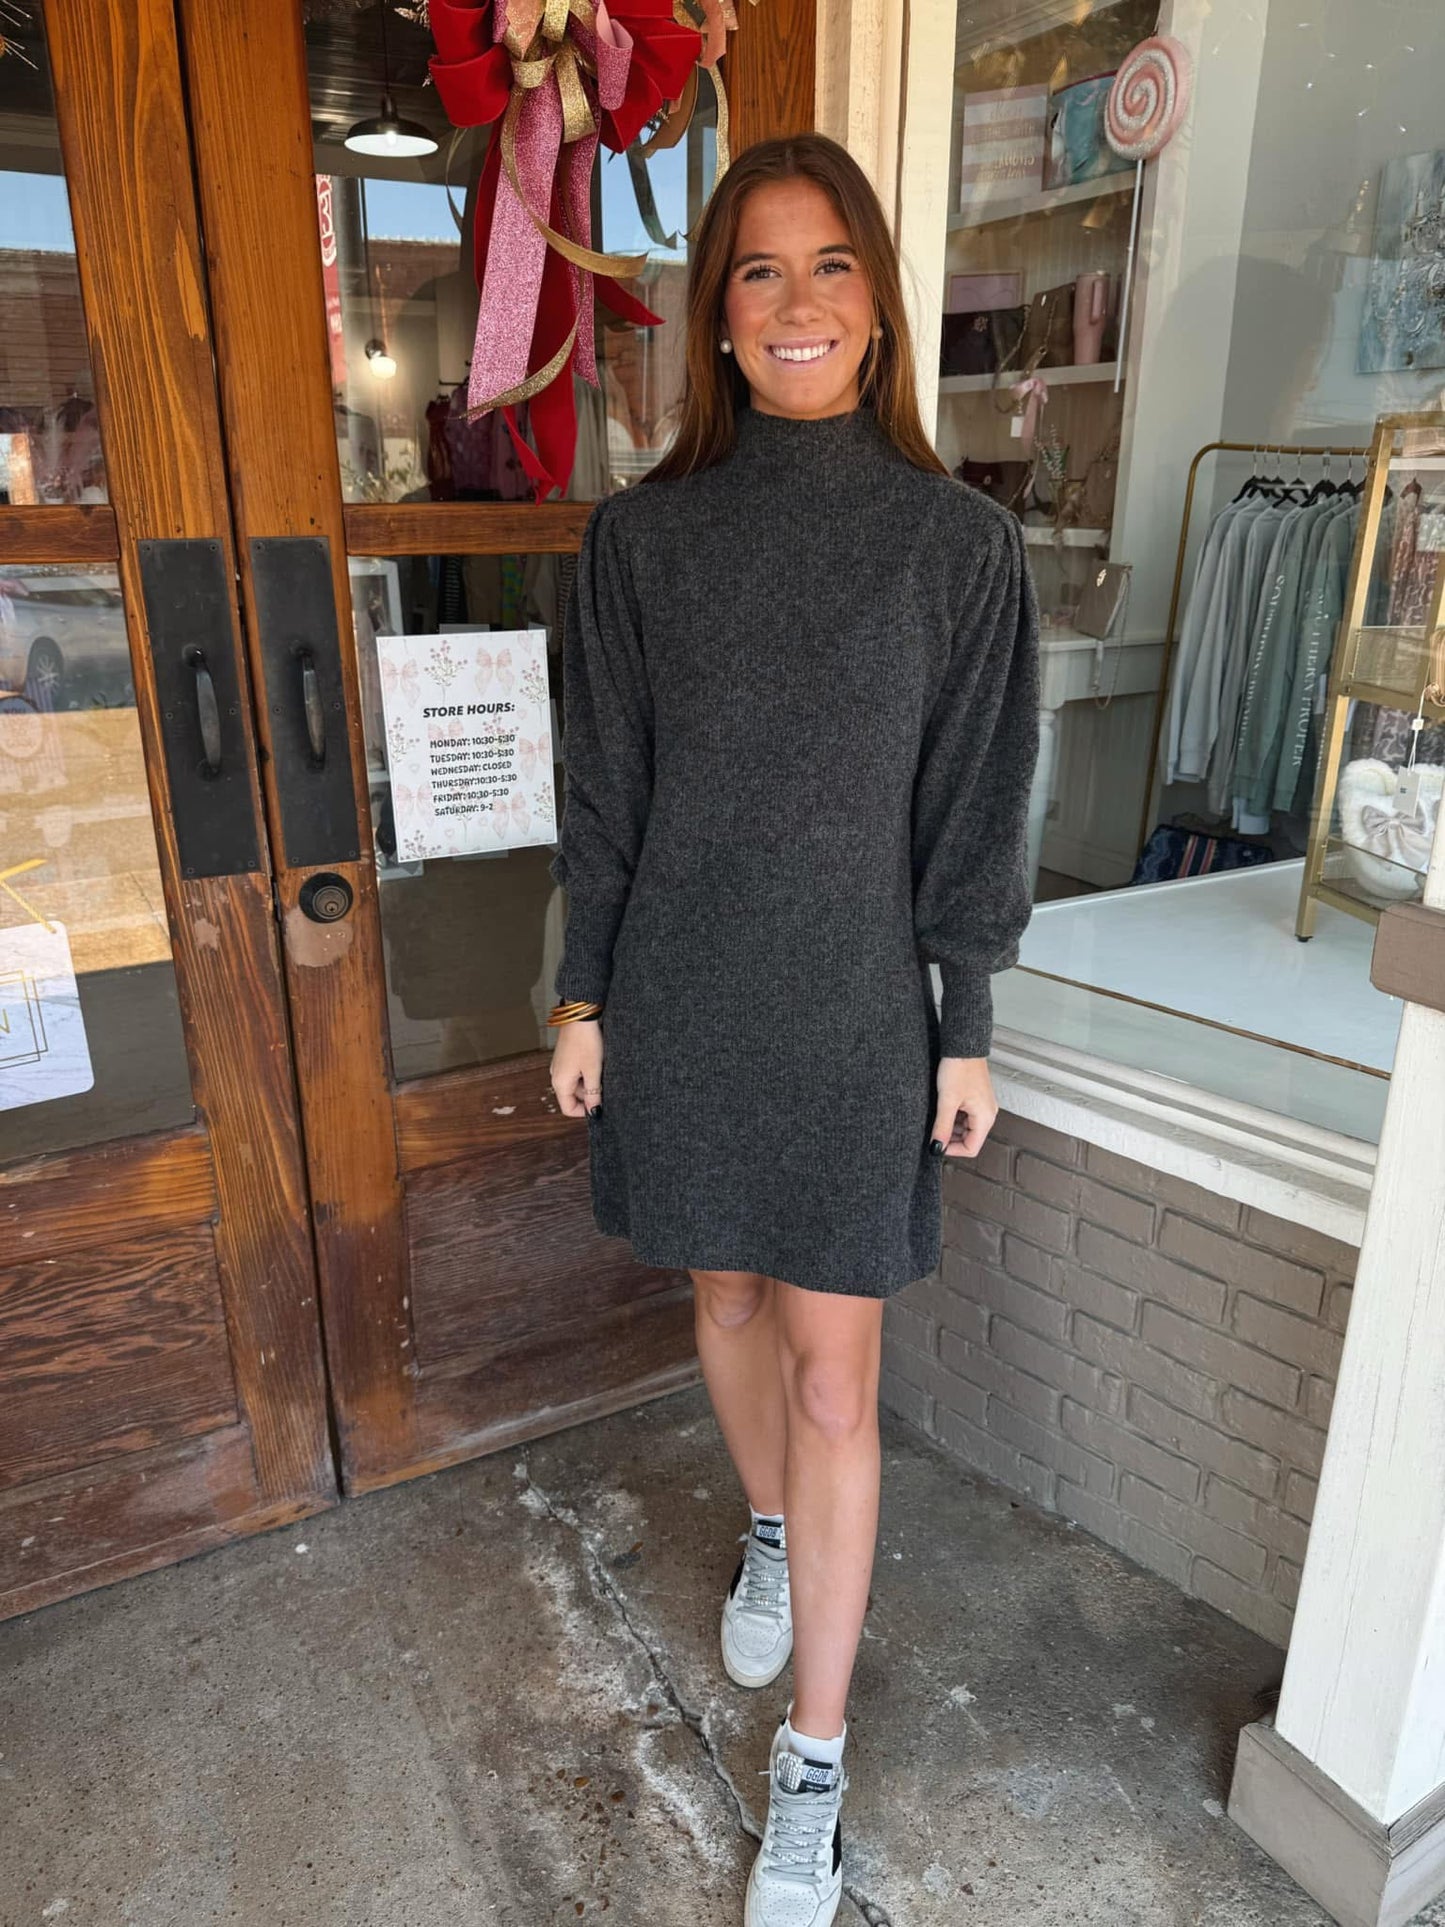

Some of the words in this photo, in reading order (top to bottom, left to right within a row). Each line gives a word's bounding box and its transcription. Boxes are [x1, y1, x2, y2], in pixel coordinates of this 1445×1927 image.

[423, 705, 464, 718] STORE
[467, 702, 515, 715] HOURS:
[430, 738, 470, 748] MONDAY:
[472, 734, 515, 745] 10:30-5:30
[430, 752, 470, 763] TUESDAY:
[472, 749, 515, 759] 10:30-5:30
[431, 764, 481, 776] WEDNESDAY:
[482, 761, 512, 771] CLOSED
[433, 792, 466, 803] FRIDAY:
[467, 788, 509, 800] 10:30-5:30
[434, 805, 479, 816] SATURDAY:
[480, 803, 493, 811] 9-2
[806, 1768, 828, 1783] GGDB
